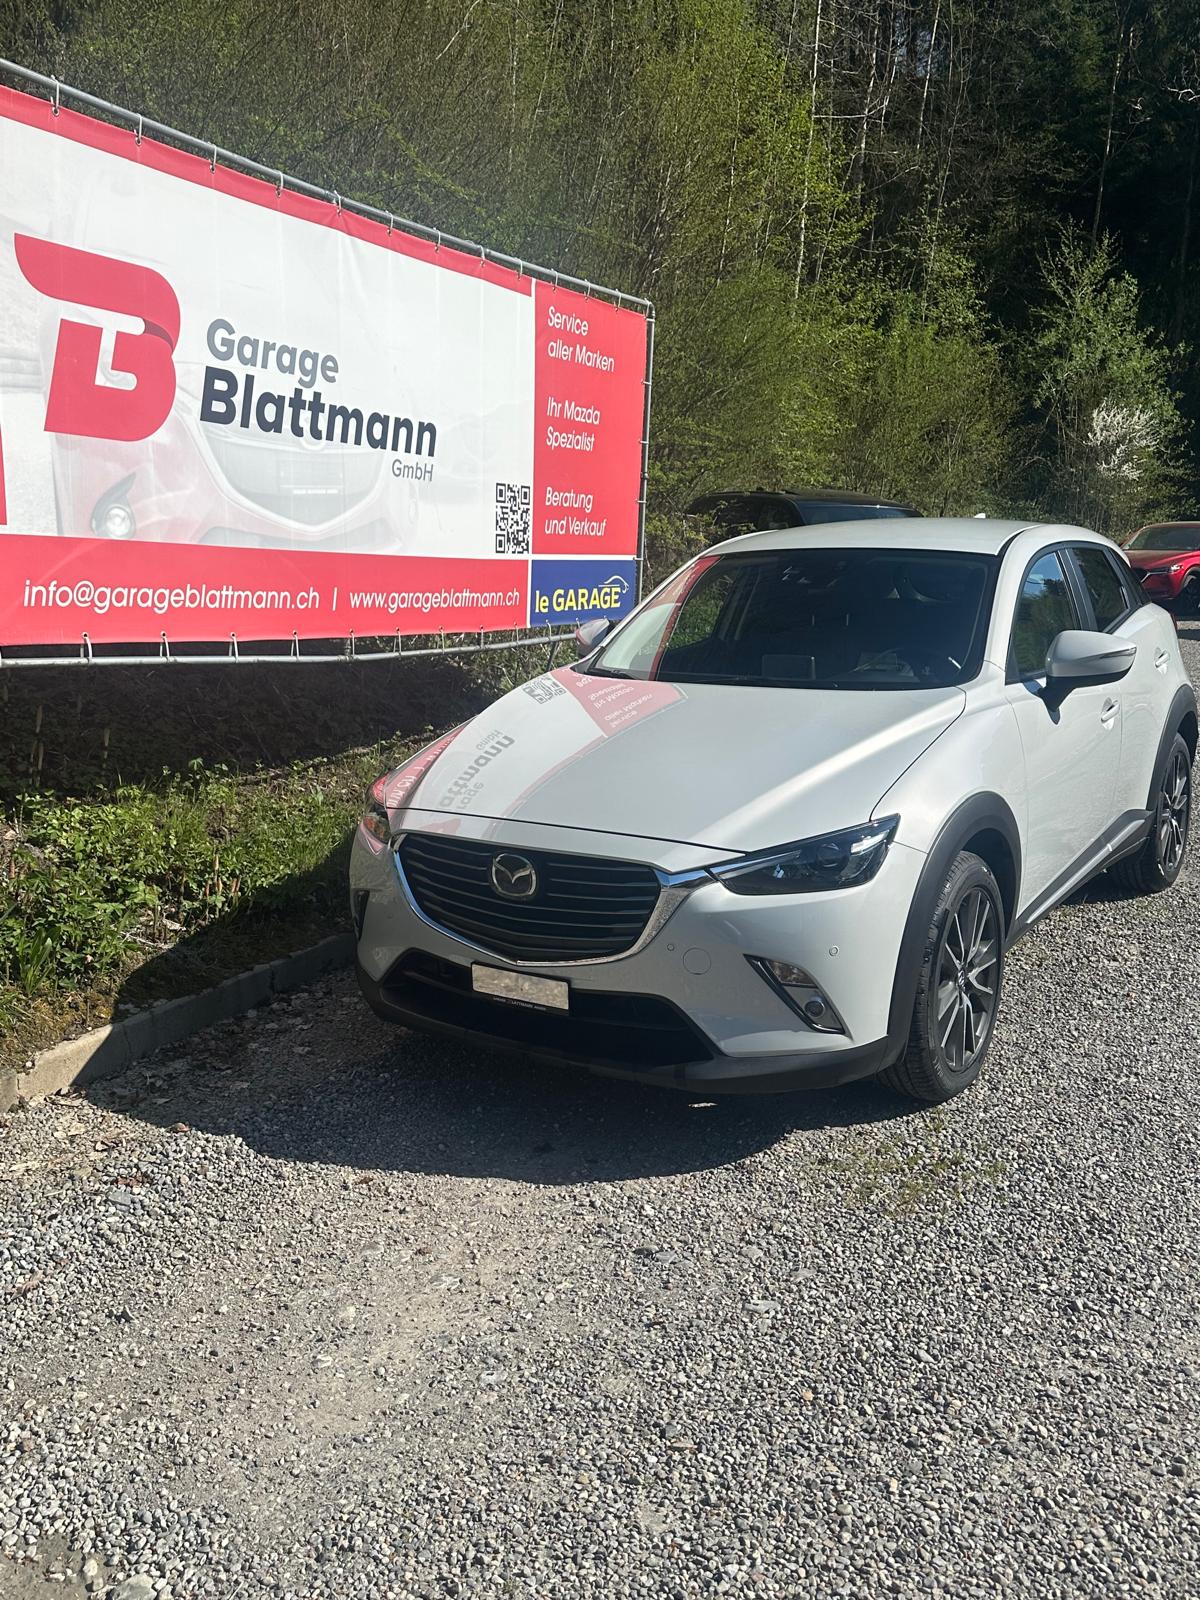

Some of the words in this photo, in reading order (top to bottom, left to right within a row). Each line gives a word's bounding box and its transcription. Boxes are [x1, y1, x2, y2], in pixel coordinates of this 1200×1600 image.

[547, 306, 589, 336] Service
[206, 318, 340, 389] Garage
[547, 339, 574, 361] aller
[575, 349, 615, 372] Marken
[200, 365, 438, 458] Blattmann
[547, 397, 562, 419] Ihr
[563, 404, 600, 425] Mazda
[546, 426, 595, 453] Spezialist
[391, 459, 434, 482] GmbH
[545, 487, 593, 514] Beratung
[544, 518, 567, 535] und
[568, 518, 607, 537] Verkauf
[23, 580, 320, 614] info@garageblattmann.ch
[350, 588, 519, 613] www.garageblattmann.ch
[534, 590, 549, 614] le
[551, 587, 621, 611] GARAGE
